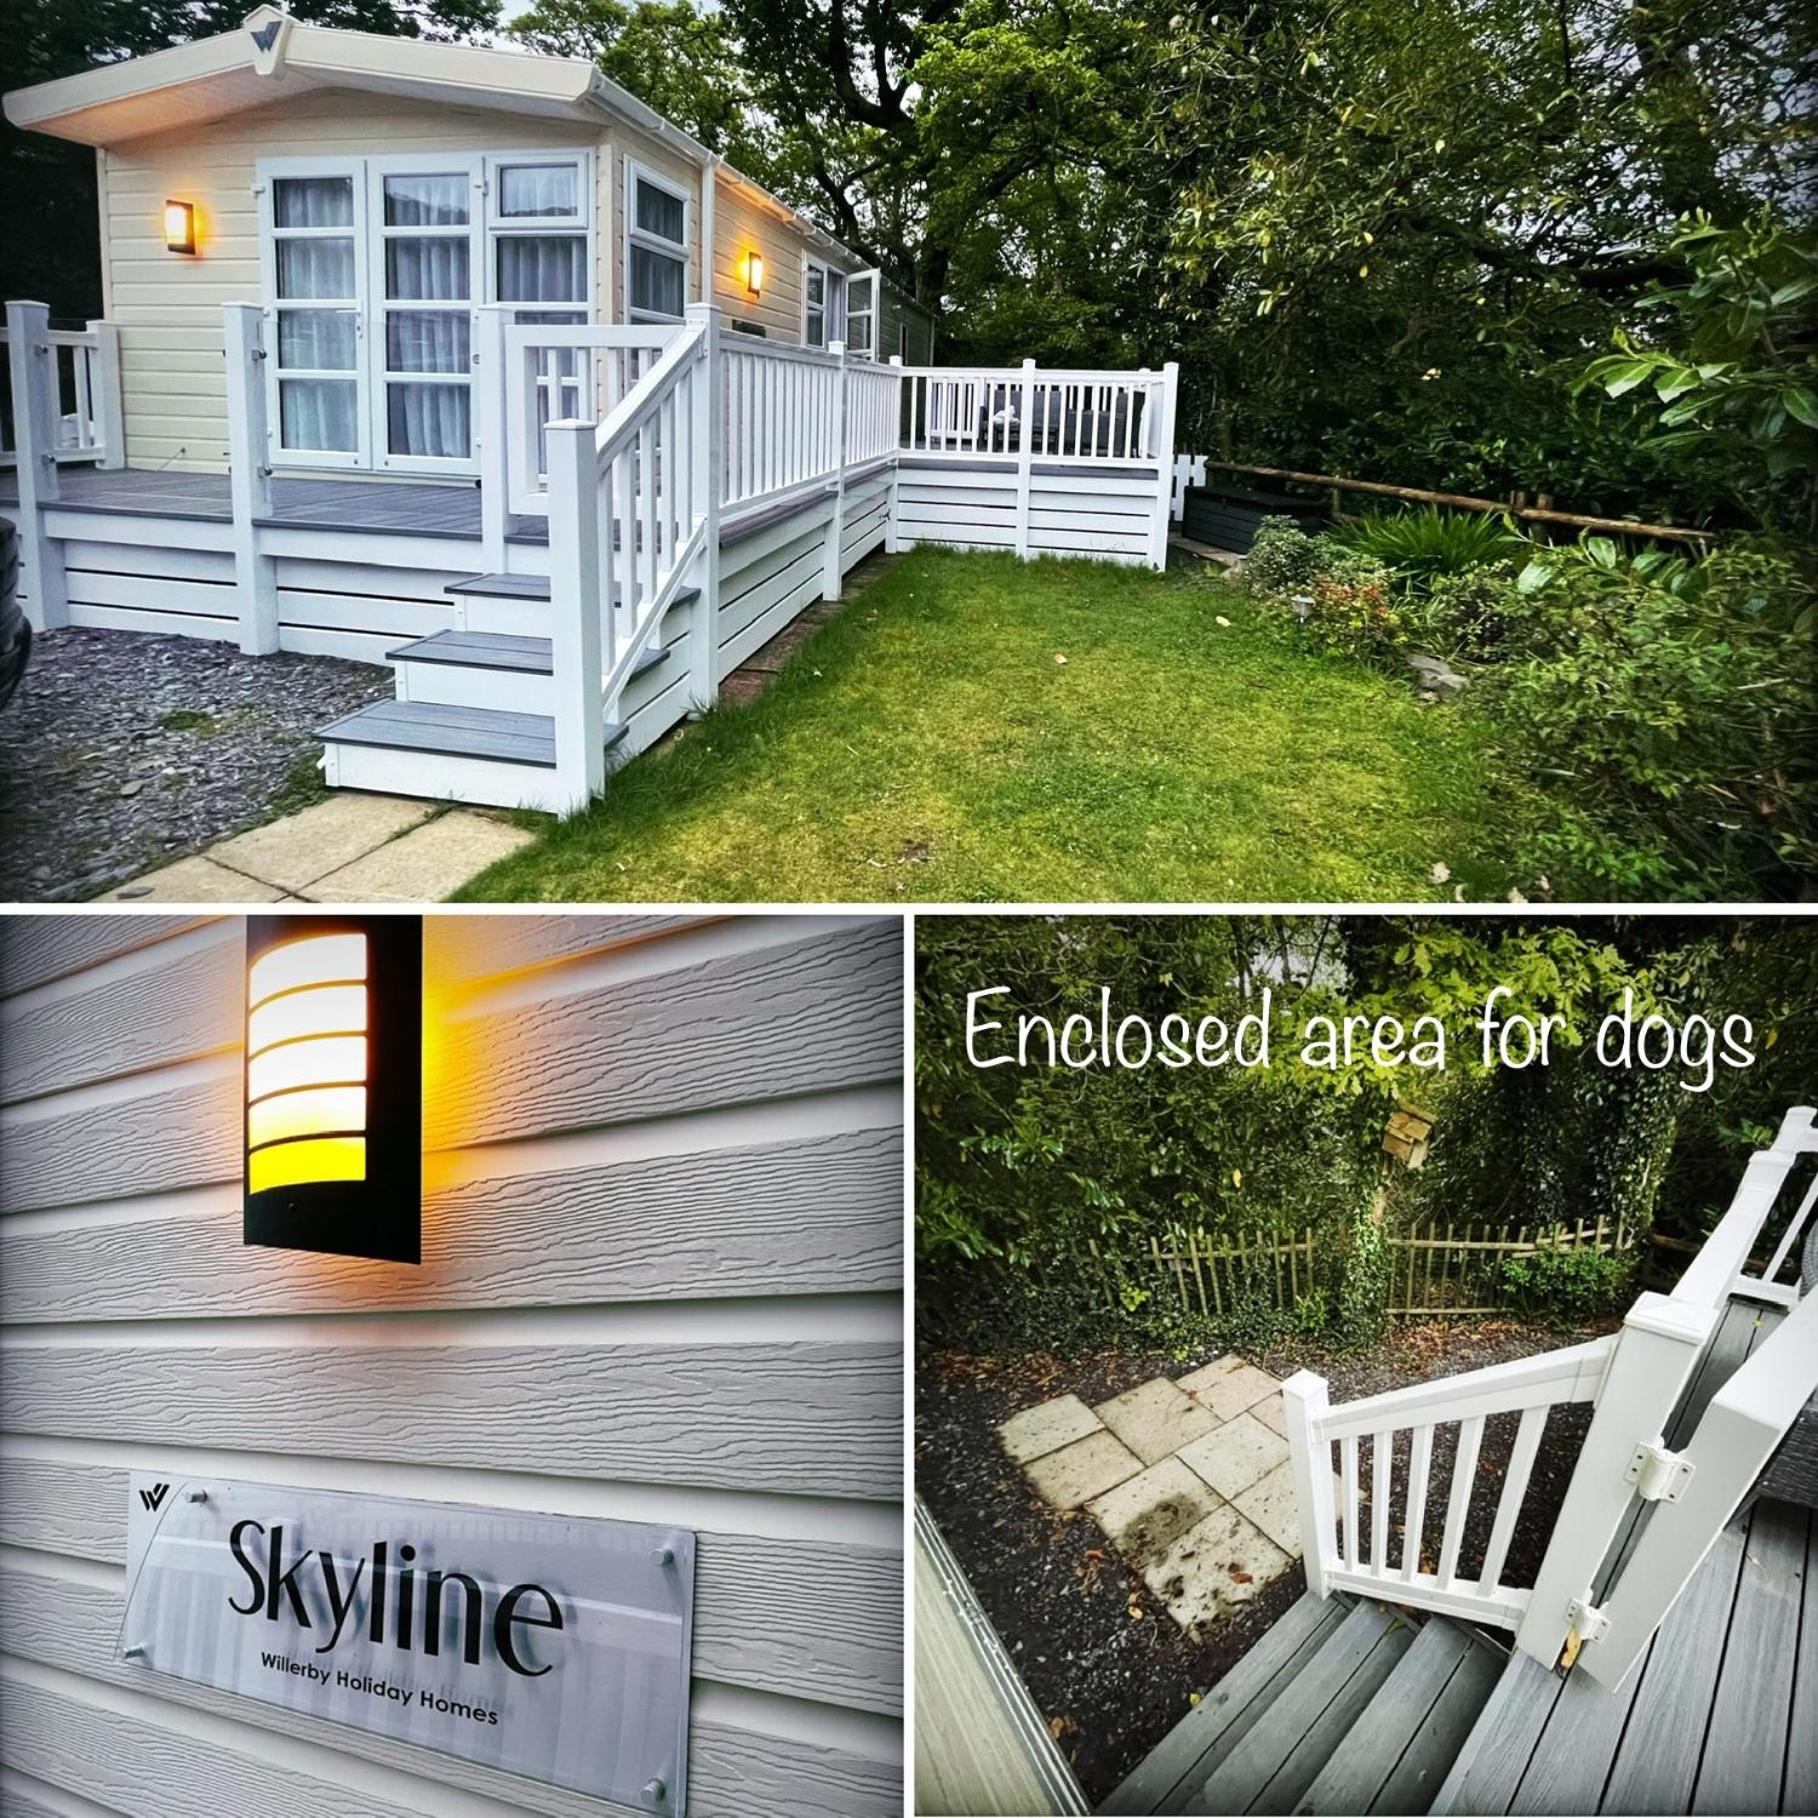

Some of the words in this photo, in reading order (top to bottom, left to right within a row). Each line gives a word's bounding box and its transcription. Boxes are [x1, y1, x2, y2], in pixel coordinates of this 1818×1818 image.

[227, 1519, 565, 1678] Skyline
[260, 1651, 331, 1686] Willerby
[336, 1670, 414, 1707] Holiday
[420, 1690, 500, 1727] Homes
